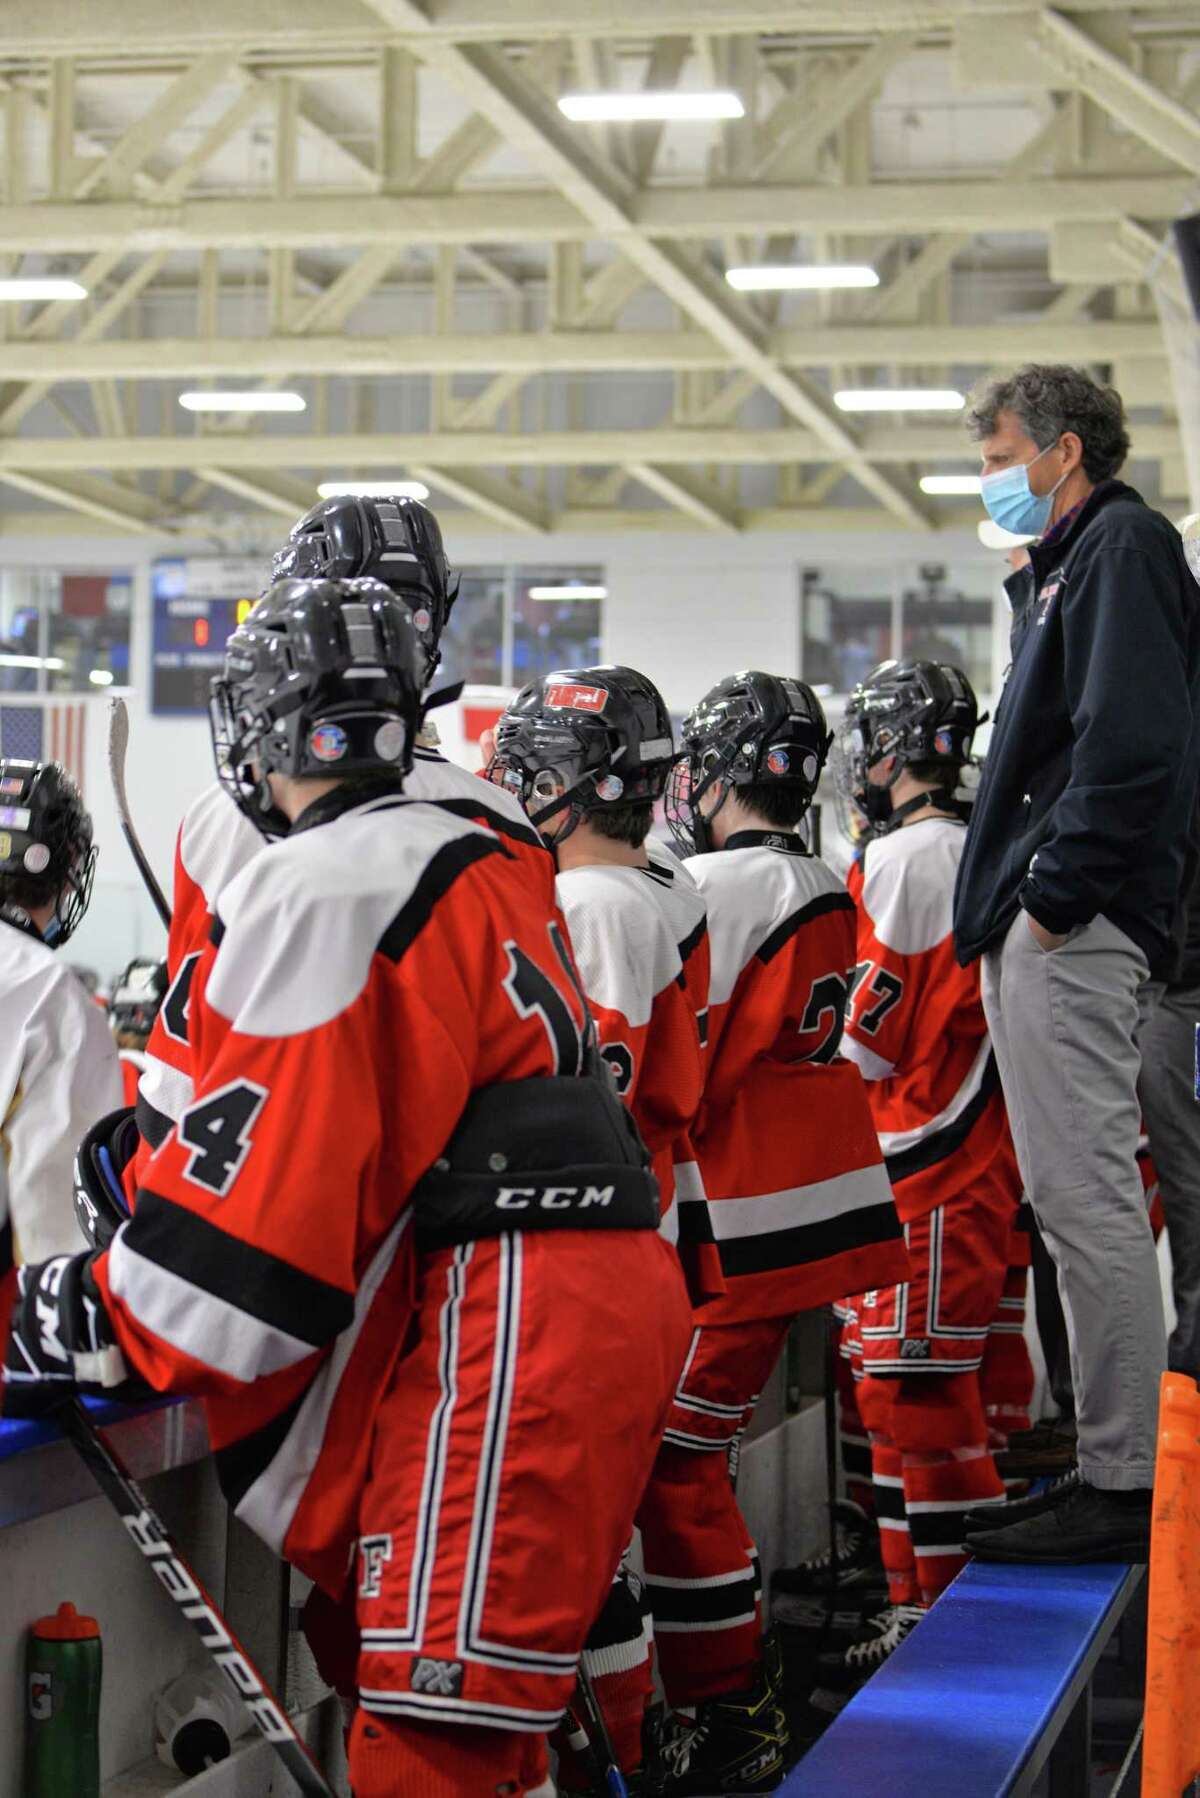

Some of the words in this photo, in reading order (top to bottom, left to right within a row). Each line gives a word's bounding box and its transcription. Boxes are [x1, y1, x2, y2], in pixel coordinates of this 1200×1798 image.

[495, 1185, 615, 1209] CCM
[359, 1533, 392, 1598] F
[122, 1509, 297, 1741] BAUER
[411, 1659, 462, 1694] PX
